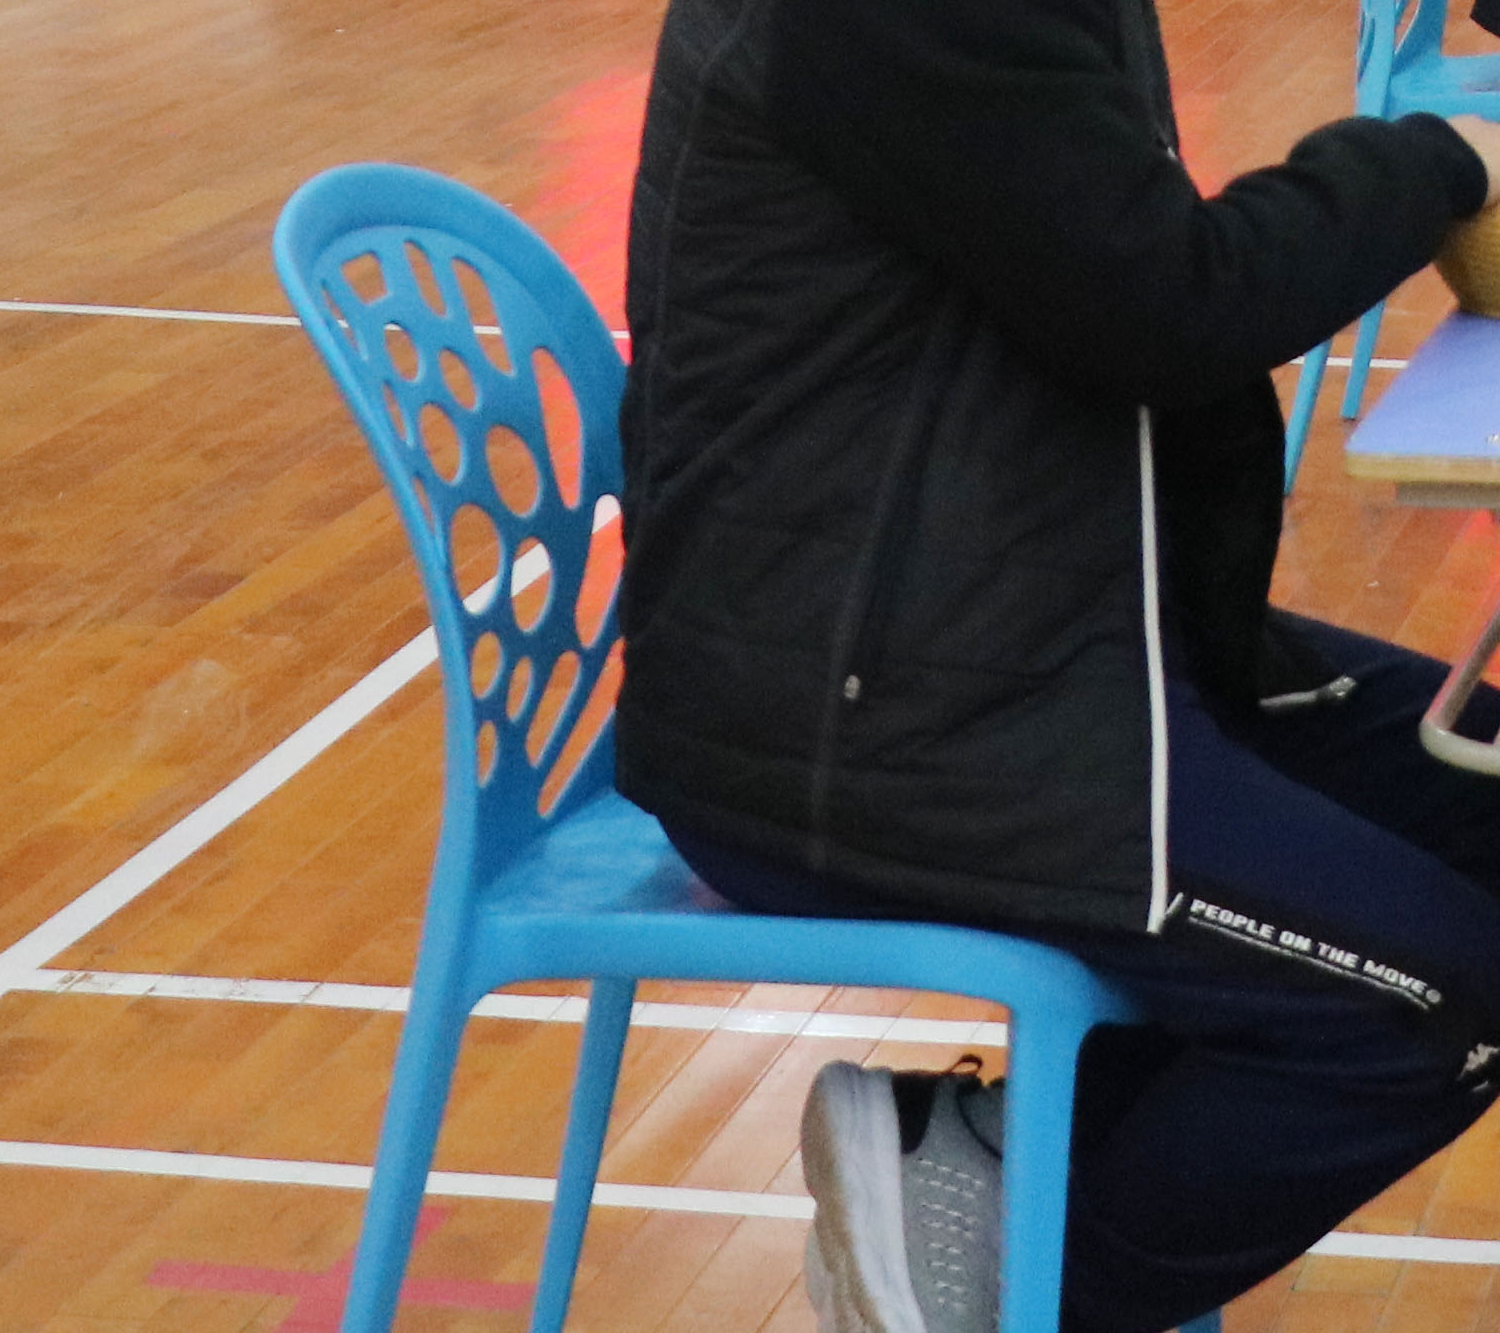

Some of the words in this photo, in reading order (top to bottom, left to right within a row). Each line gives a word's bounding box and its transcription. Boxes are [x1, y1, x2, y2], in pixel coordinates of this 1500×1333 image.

[1189, 898, 1276, 940] PEOPLE
[1278, 930, 1313, 953] ON
[1317, 941, 1360, 969] THE
